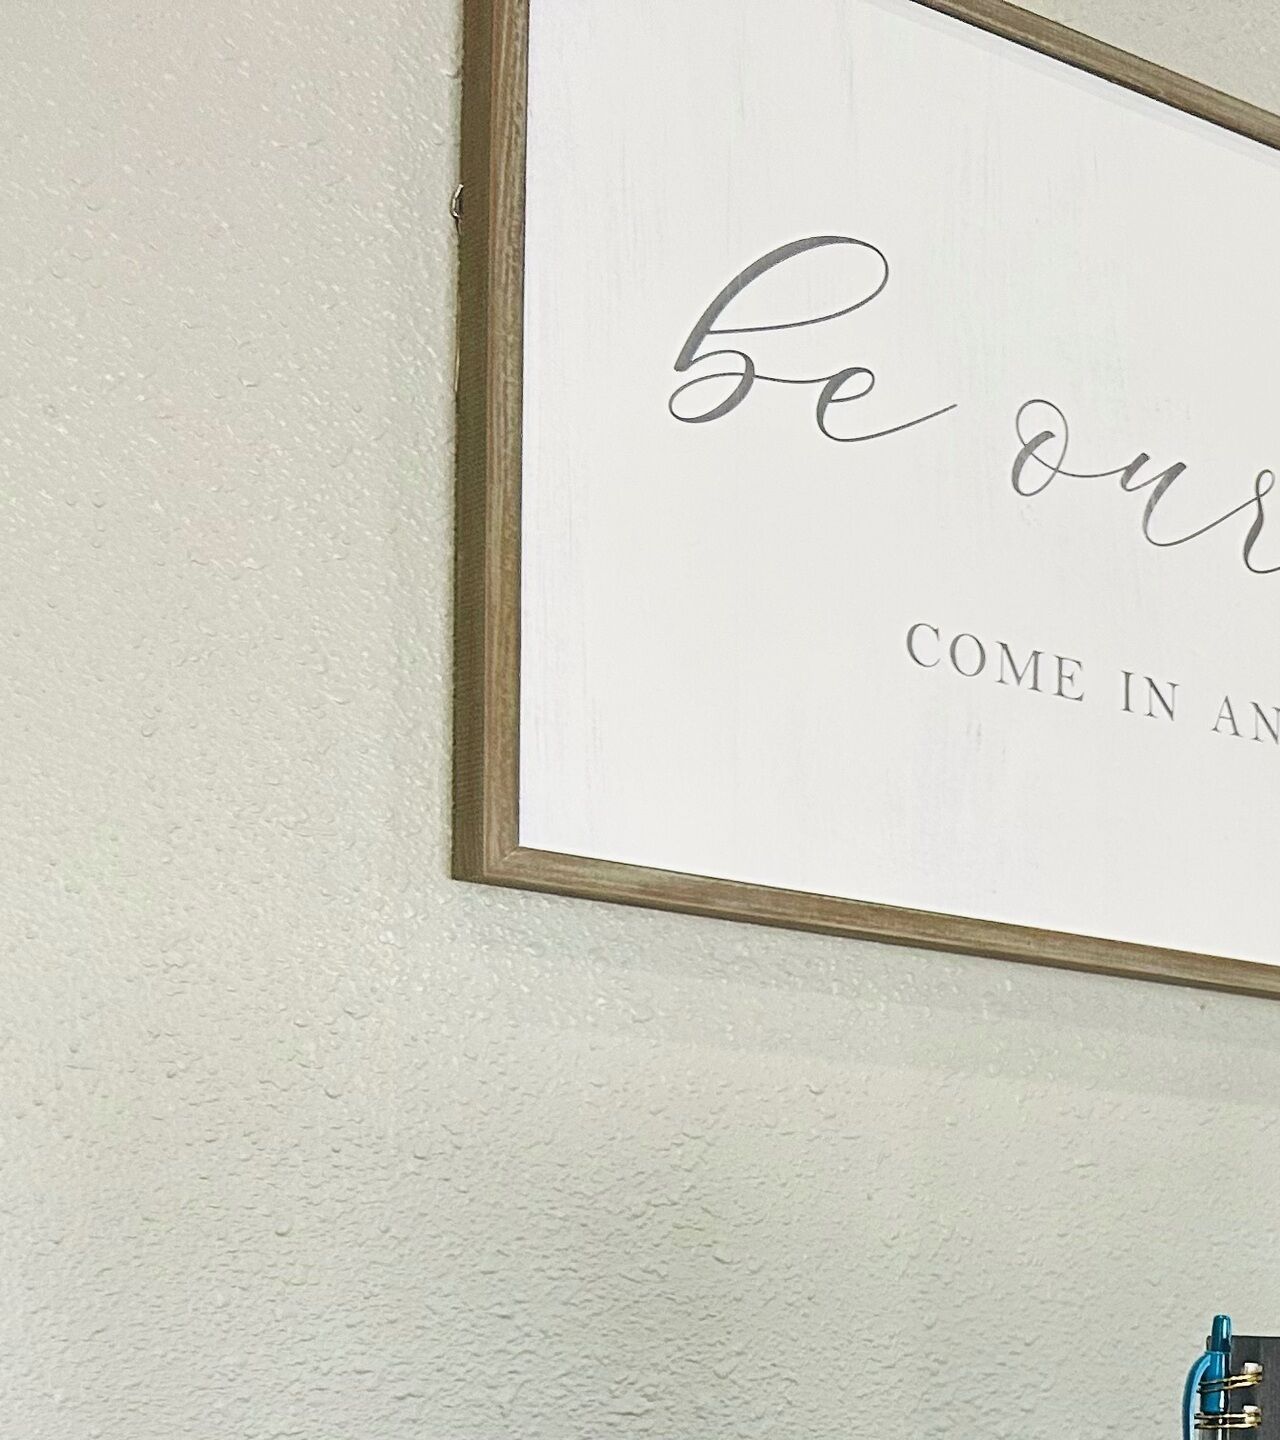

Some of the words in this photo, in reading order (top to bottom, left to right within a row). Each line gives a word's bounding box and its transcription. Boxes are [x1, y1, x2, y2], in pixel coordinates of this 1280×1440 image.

[668, 235, 958, 443] be
[906, 622, 1086, 703] COME
[1119, 670, 1180, 722] IN
